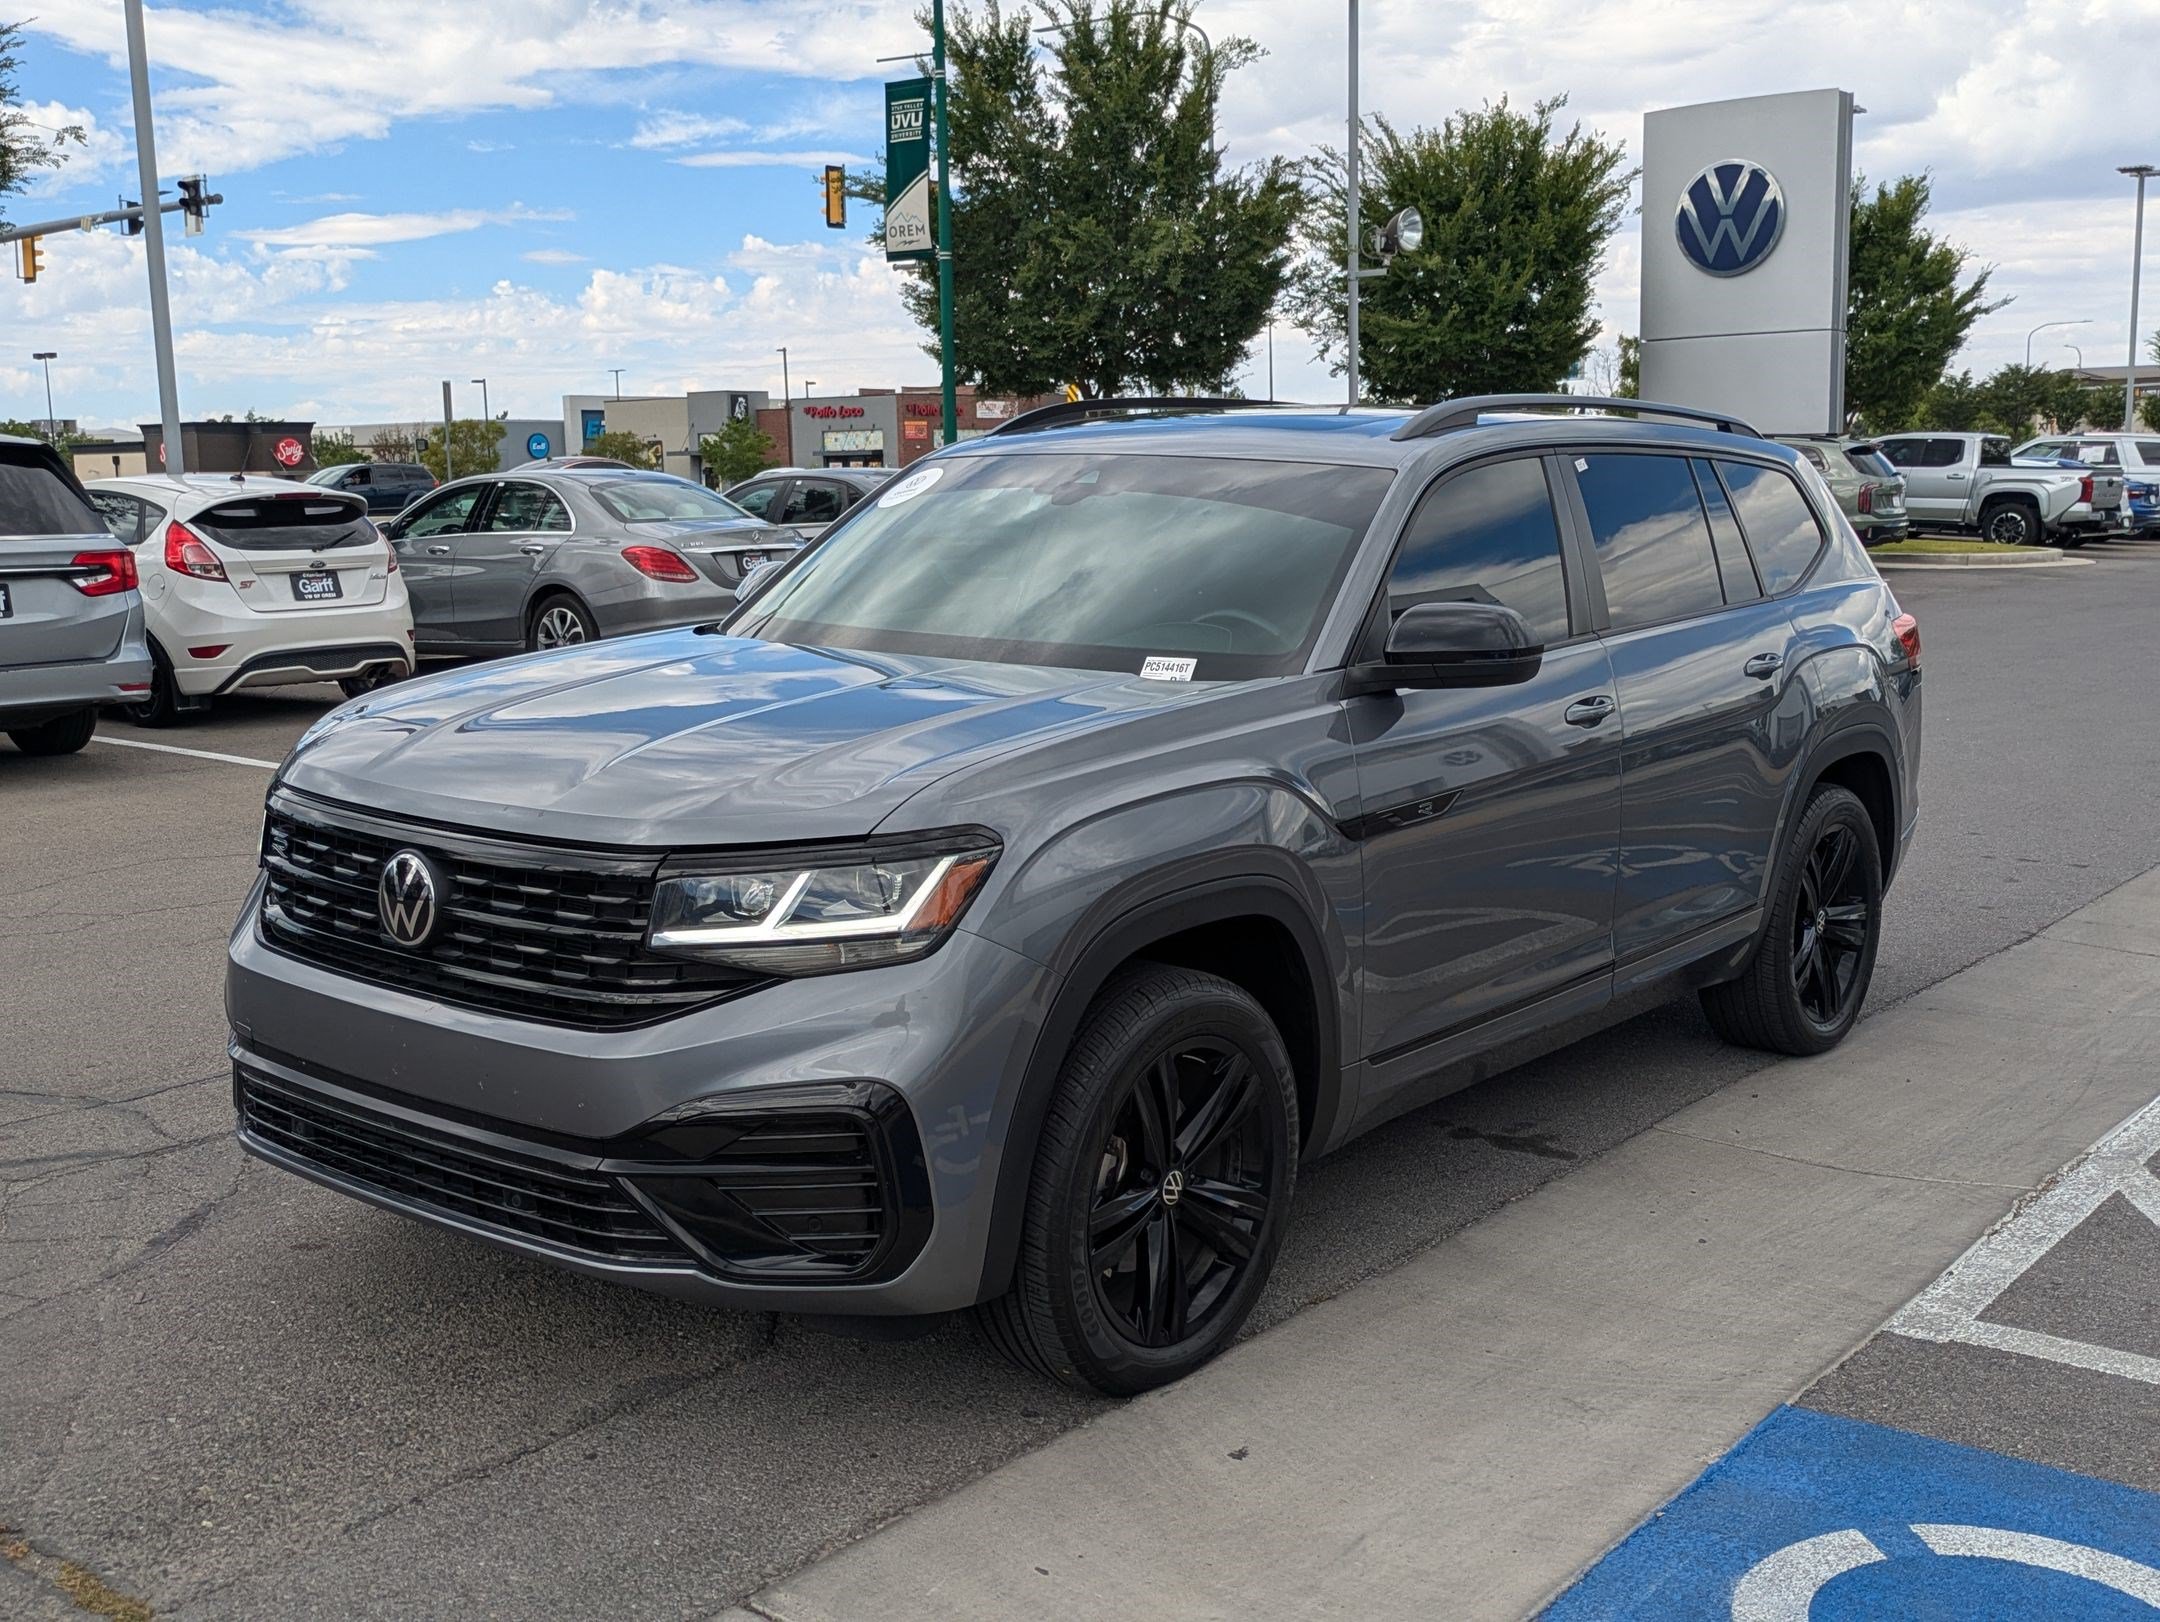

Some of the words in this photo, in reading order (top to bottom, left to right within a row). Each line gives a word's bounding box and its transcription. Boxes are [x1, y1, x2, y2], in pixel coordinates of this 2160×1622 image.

[891, 111, 923, 129] UVU
[1675, 159, 1784, 278] VW
[888, 224, 926, 238] OREM
[839, 405, 864, 419] Loco
[277, 442, 304, 461] Swig
[239, 580, 256, 589] ST
[299, 577, 333, 593] Garff
[1144, 661, 1190, 673] PC514416T
